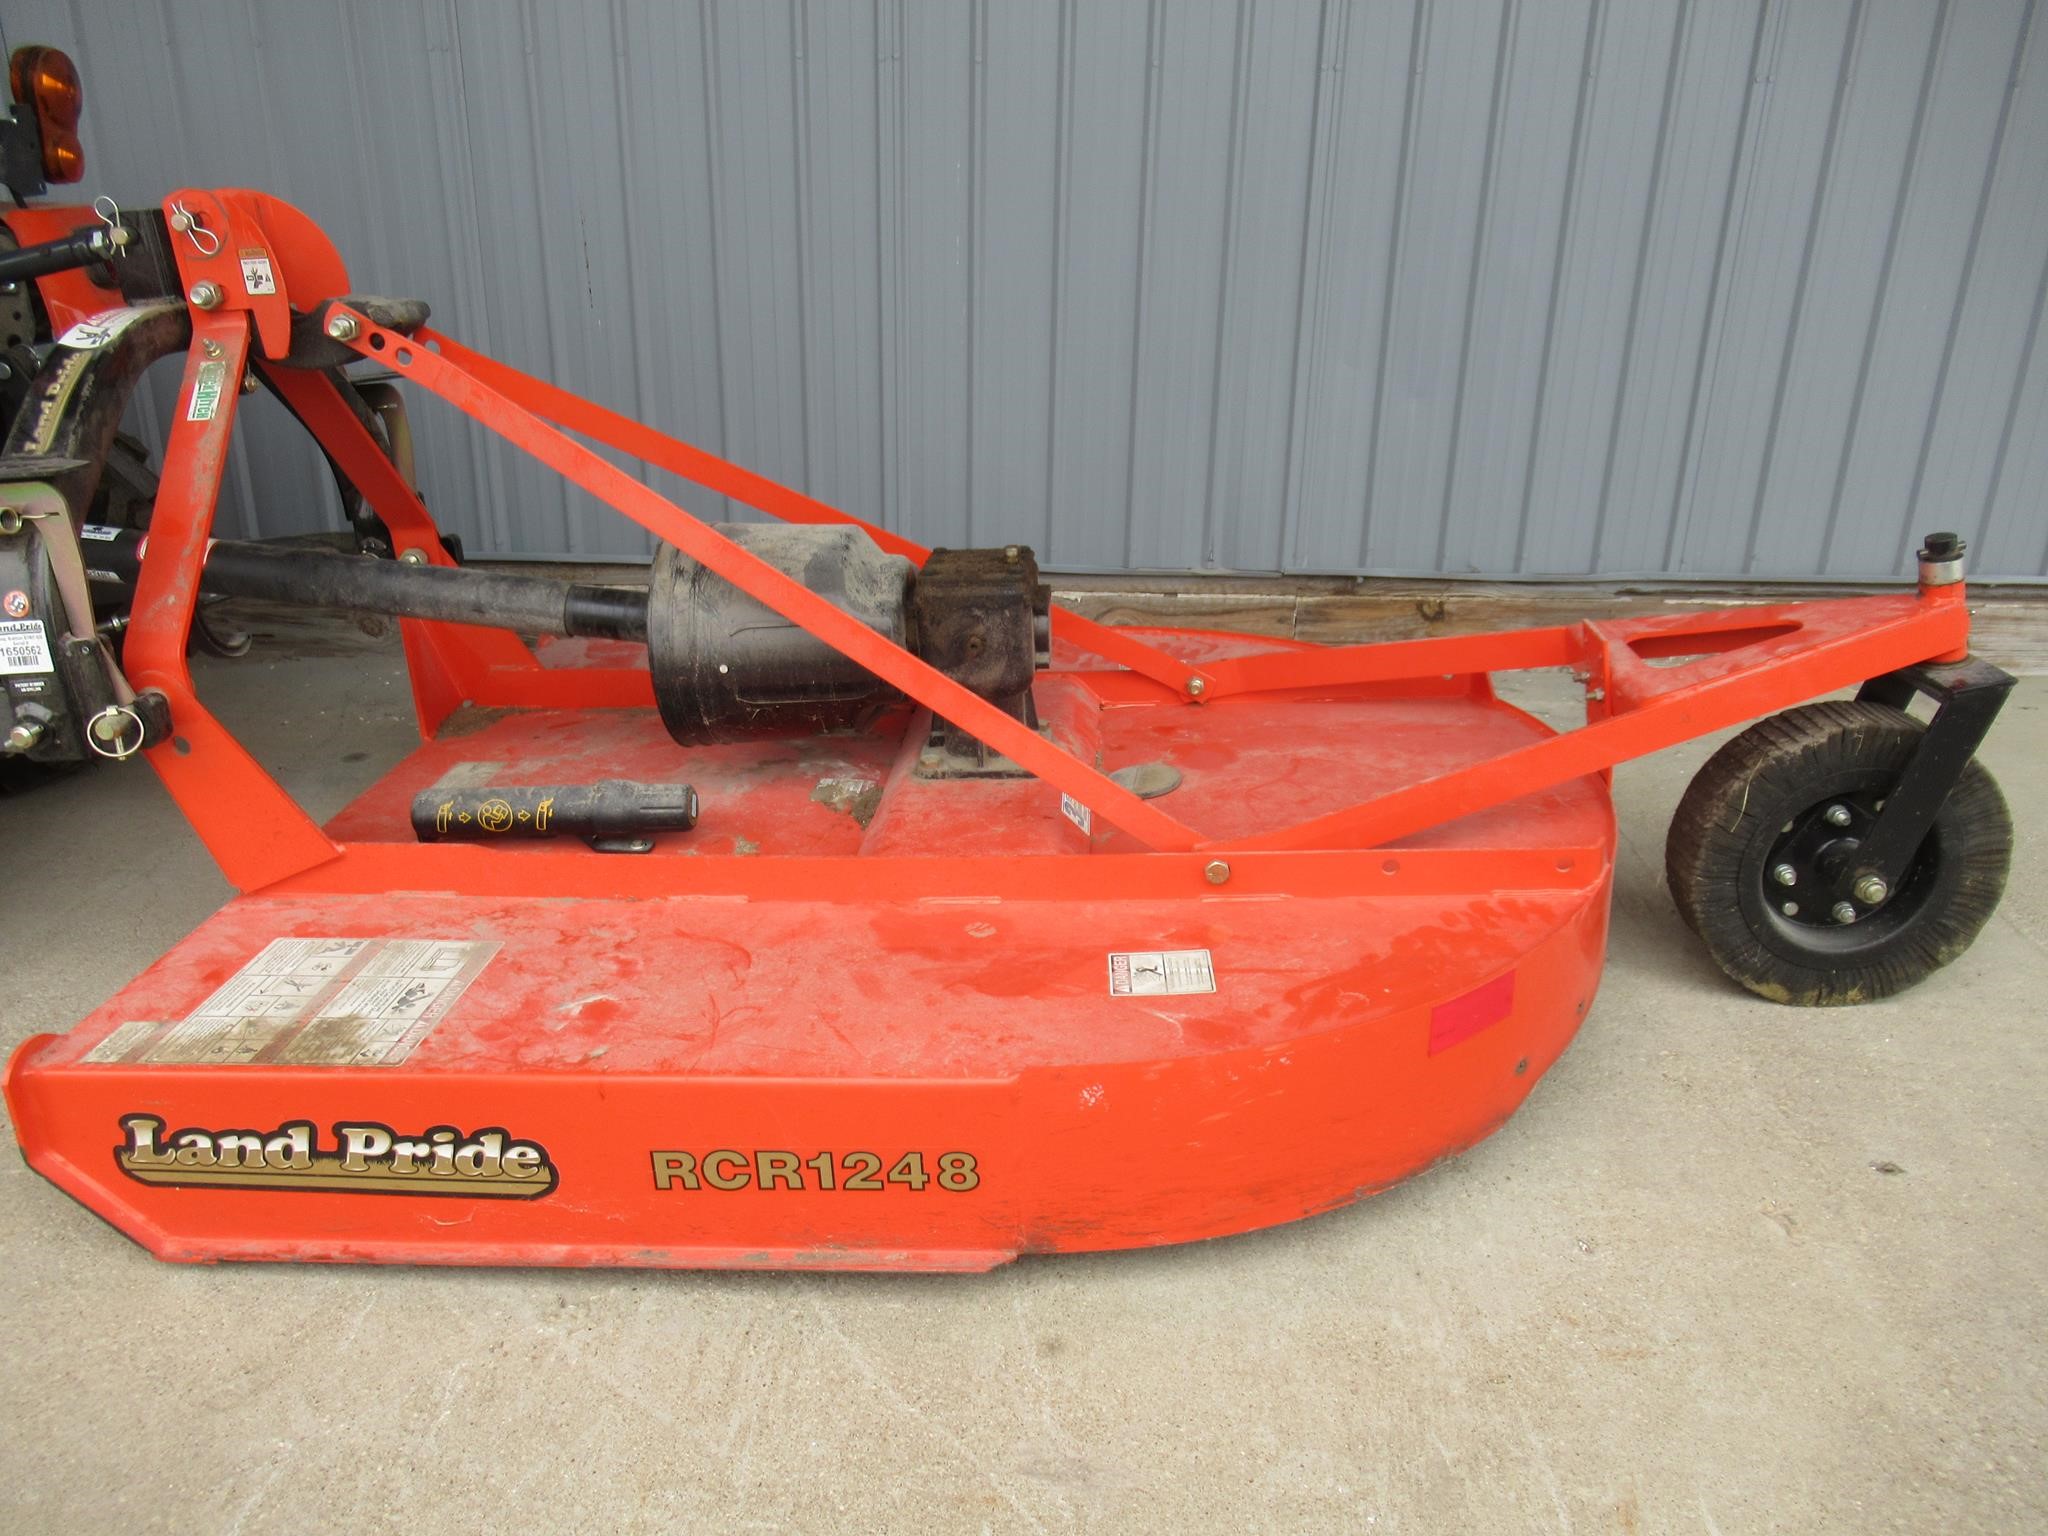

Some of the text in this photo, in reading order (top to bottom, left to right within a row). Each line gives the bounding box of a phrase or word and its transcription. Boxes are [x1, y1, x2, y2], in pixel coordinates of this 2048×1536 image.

[127, 1119, 542, 1178] Land Pride
[650, 1150, 980, 1192] RCR1248
